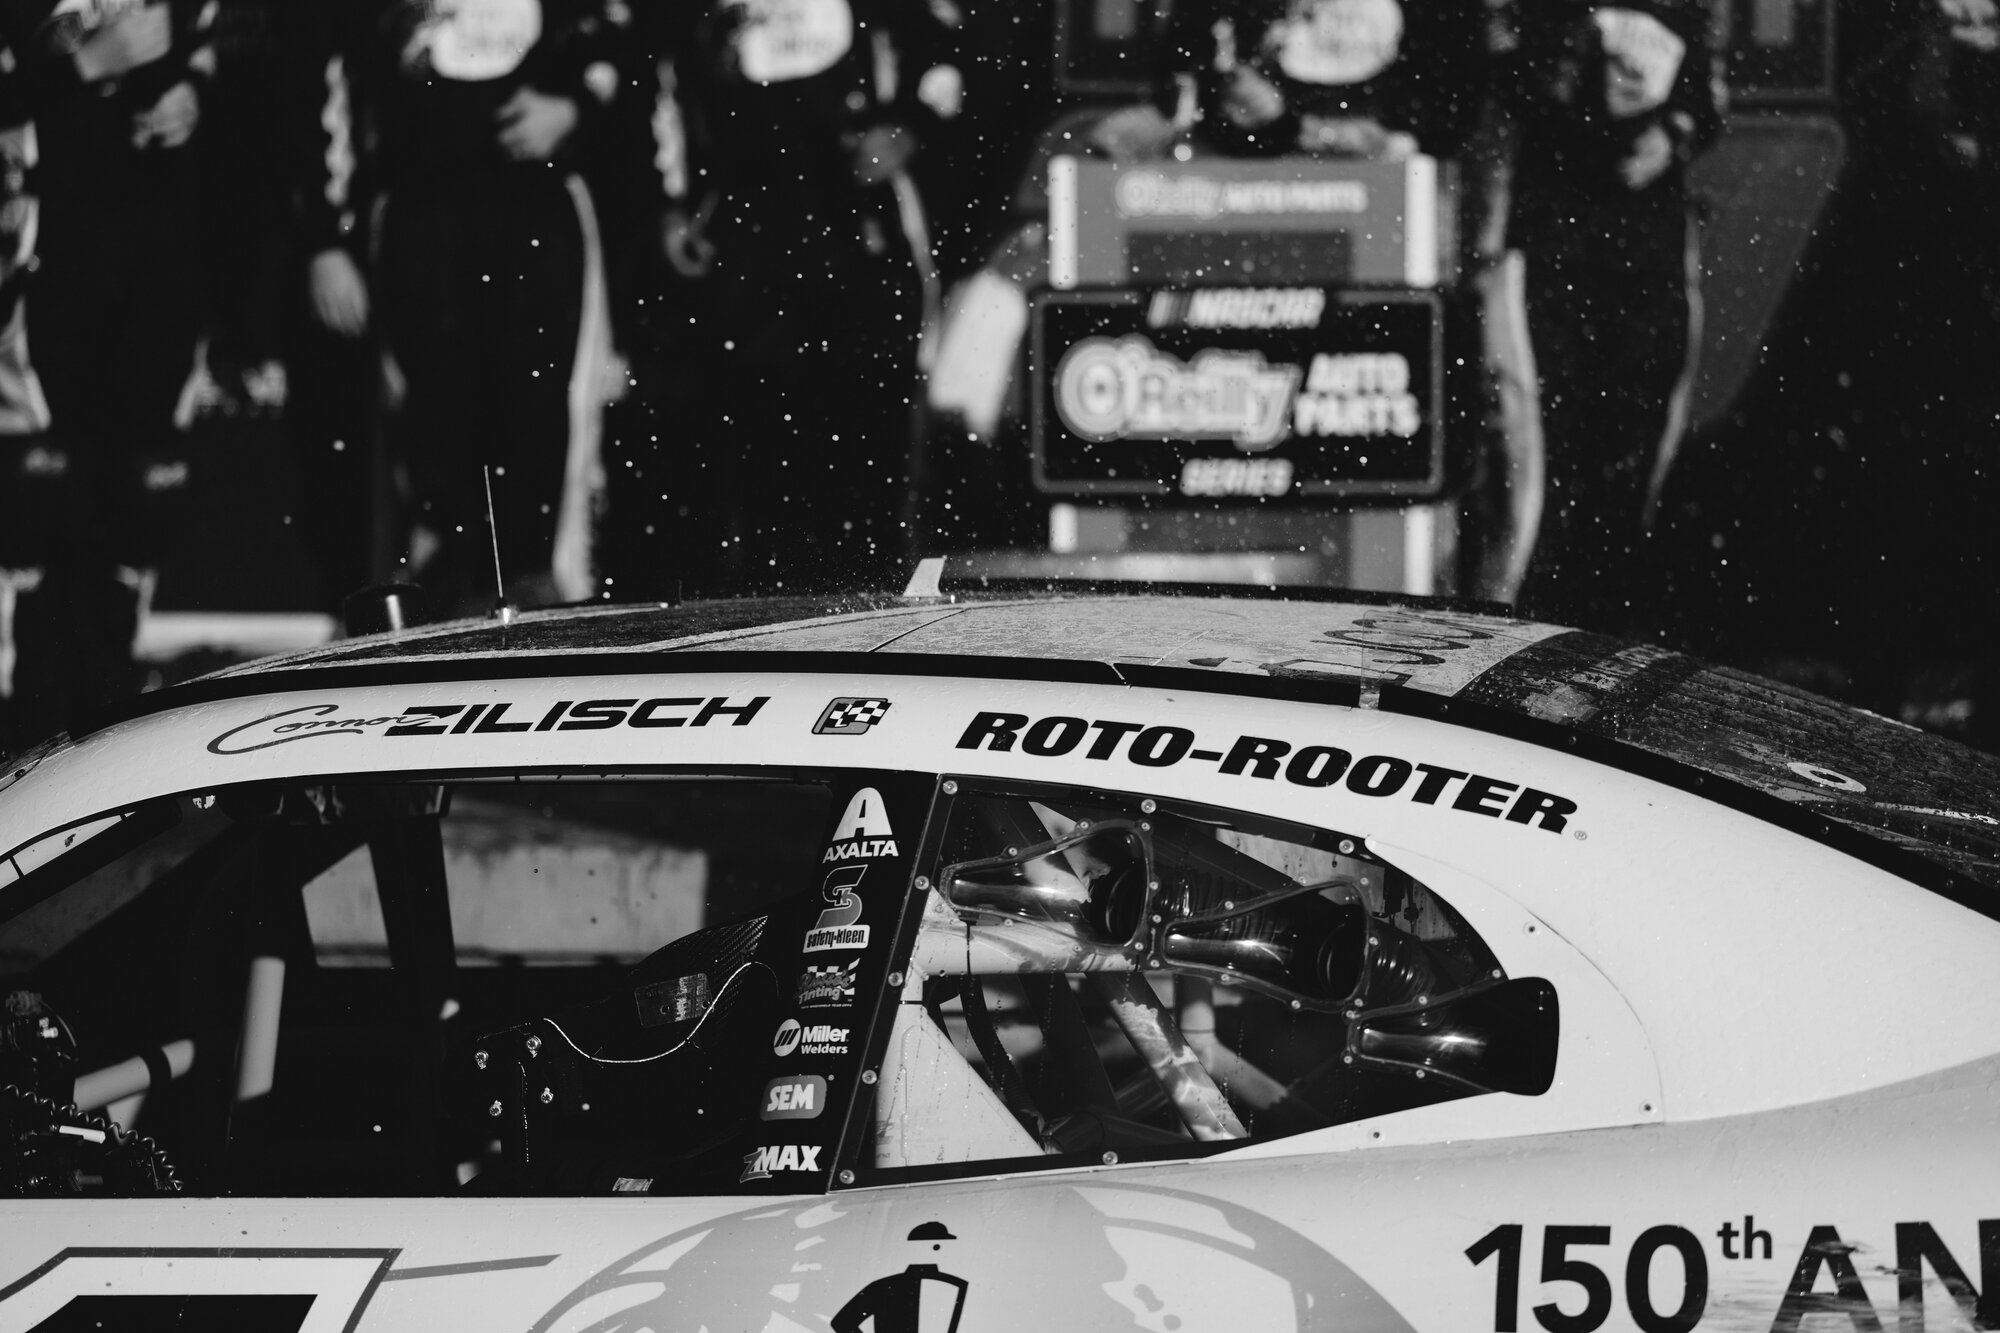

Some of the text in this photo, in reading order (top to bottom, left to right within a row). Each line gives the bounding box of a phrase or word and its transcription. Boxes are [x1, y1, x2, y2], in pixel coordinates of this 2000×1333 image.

[1186, 289, 1326, 328] NASCAR
[1308, 354, 1410, 394] AUTO
[1056, 340, 1302, 450] O'Reilly
[1296, 393, 1421, 436] PARTS
[1182, 459, 1293, 496] SERIES
[206, 697, 772, 755] Connor ZILISCH
[955, 711, 1579, 835] ROTO-ROOTER
[822, 840, 899, 864] AXALTA
[799, 986, 840, 1005] Tinting
[801, 1025, 850, 1043] Miller
[801, 1044, 848, 1054] Welders
[766, 1083, 815, 1112] SEM
